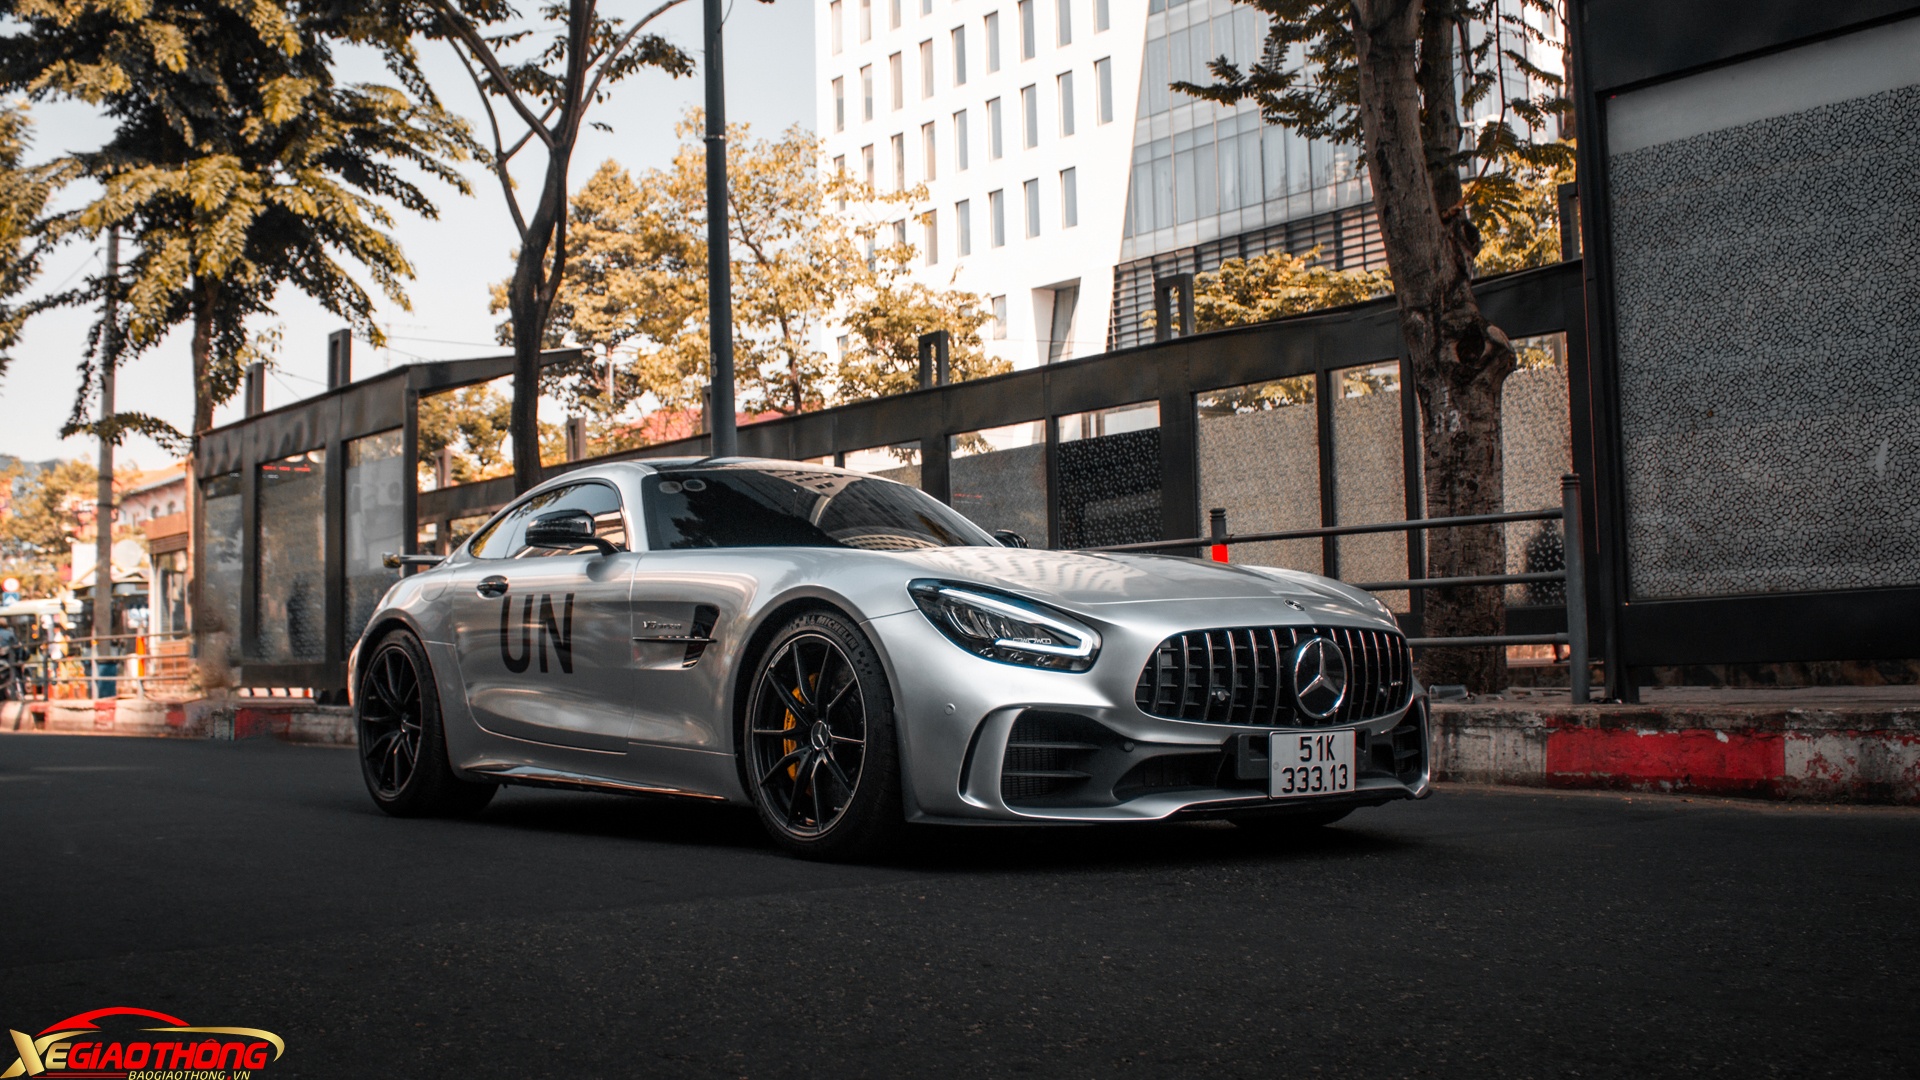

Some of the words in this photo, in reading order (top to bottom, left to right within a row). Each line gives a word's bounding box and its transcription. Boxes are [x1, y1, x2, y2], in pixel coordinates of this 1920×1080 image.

[501, 593, 575, 674] UN
[816, 614, 860, 652] MICHELIN
[1299, 735, 1335, 762] 51K
[1281, 763, 1348, 793] 333.13
